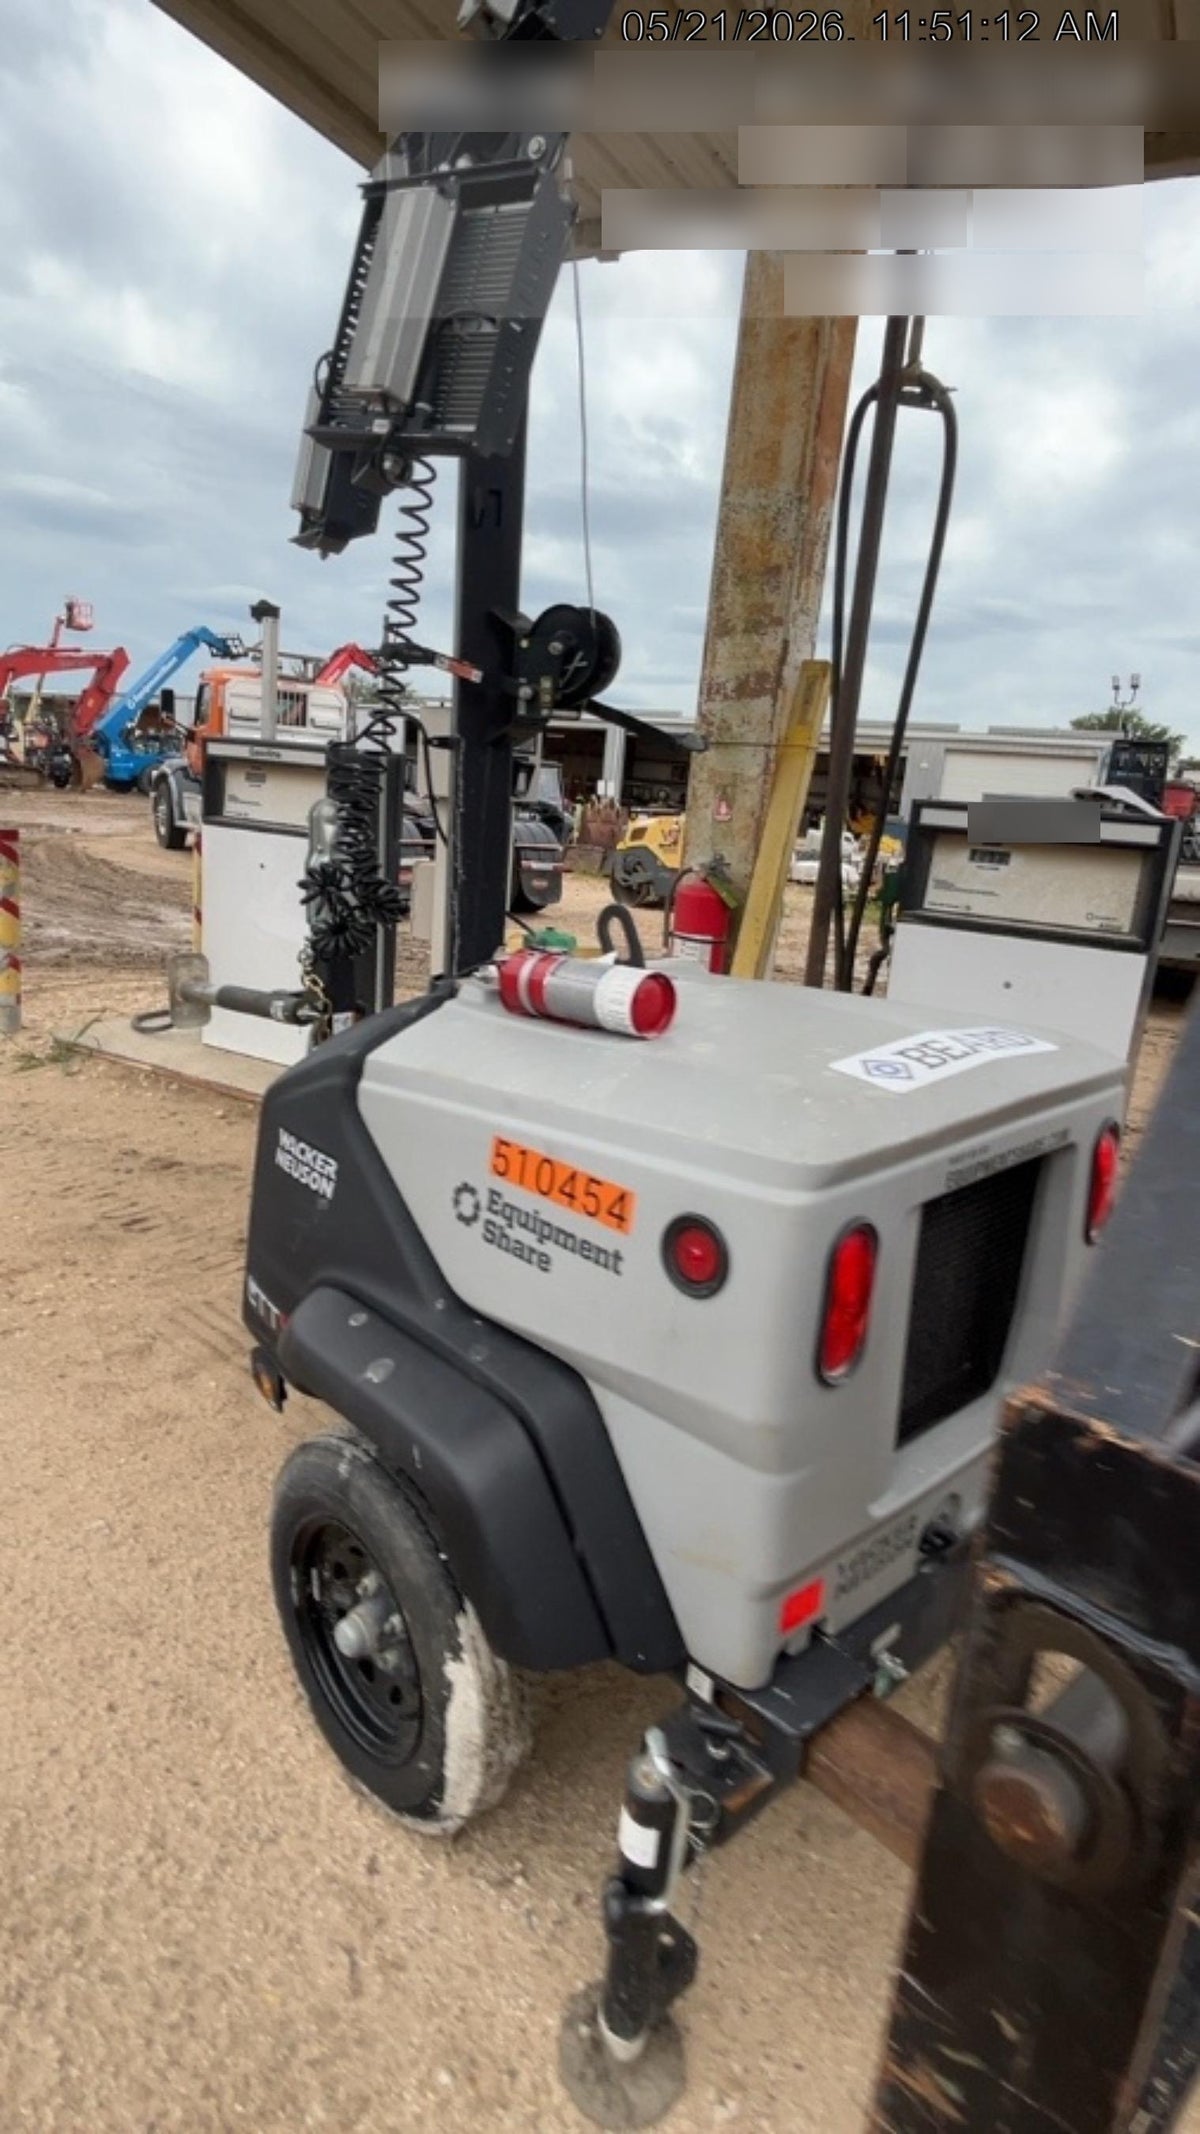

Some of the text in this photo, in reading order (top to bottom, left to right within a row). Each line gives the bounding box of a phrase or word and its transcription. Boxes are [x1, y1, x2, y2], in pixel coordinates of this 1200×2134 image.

[275, 1147, 336, 1200] NEUSON
[279, 1127, 338, 1181] WACKER
[491, 1138, 628, 1231] 510454
[481, 1217, 552, 1273] Share
[486, 1187, 623, 1276] Equipment
